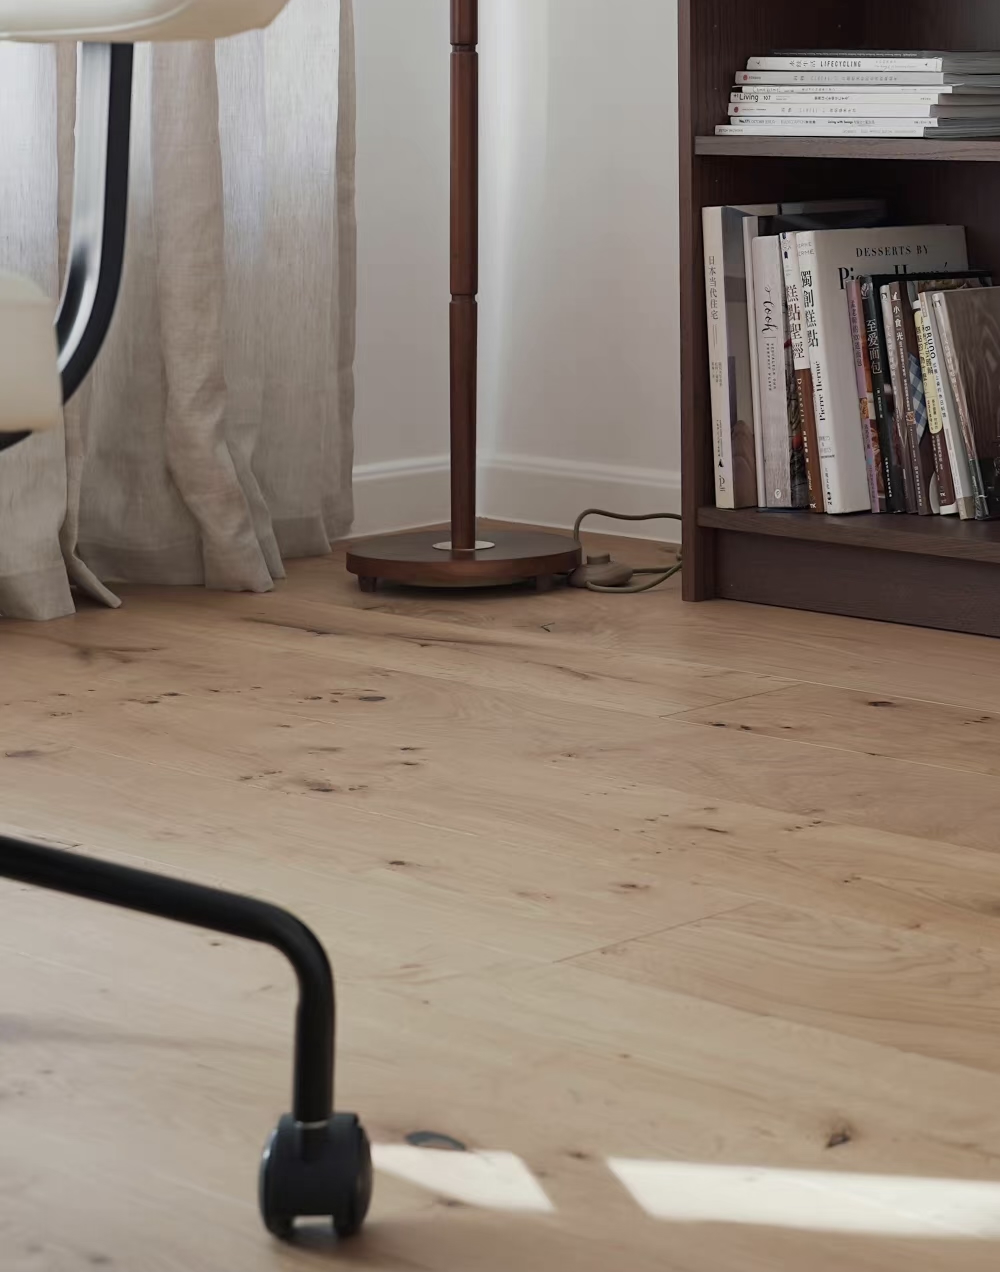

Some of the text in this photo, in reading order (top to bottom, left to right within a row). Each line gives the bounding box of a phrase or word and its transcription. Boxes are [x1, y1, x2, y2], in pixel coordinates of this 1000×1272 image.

[820, 60, 862, 68] LIFECYCLING
[739, 93, 759, 103] Living
[856, 244, 929, 257] DESSERTS BY
[708, 255, 719, 320] 日本当代住宅
[787, 284, 805, 359] 糕點聖經
[866, 318, 883, 374] 至爱面包
[925, 325, 936, 359] BRUNO
